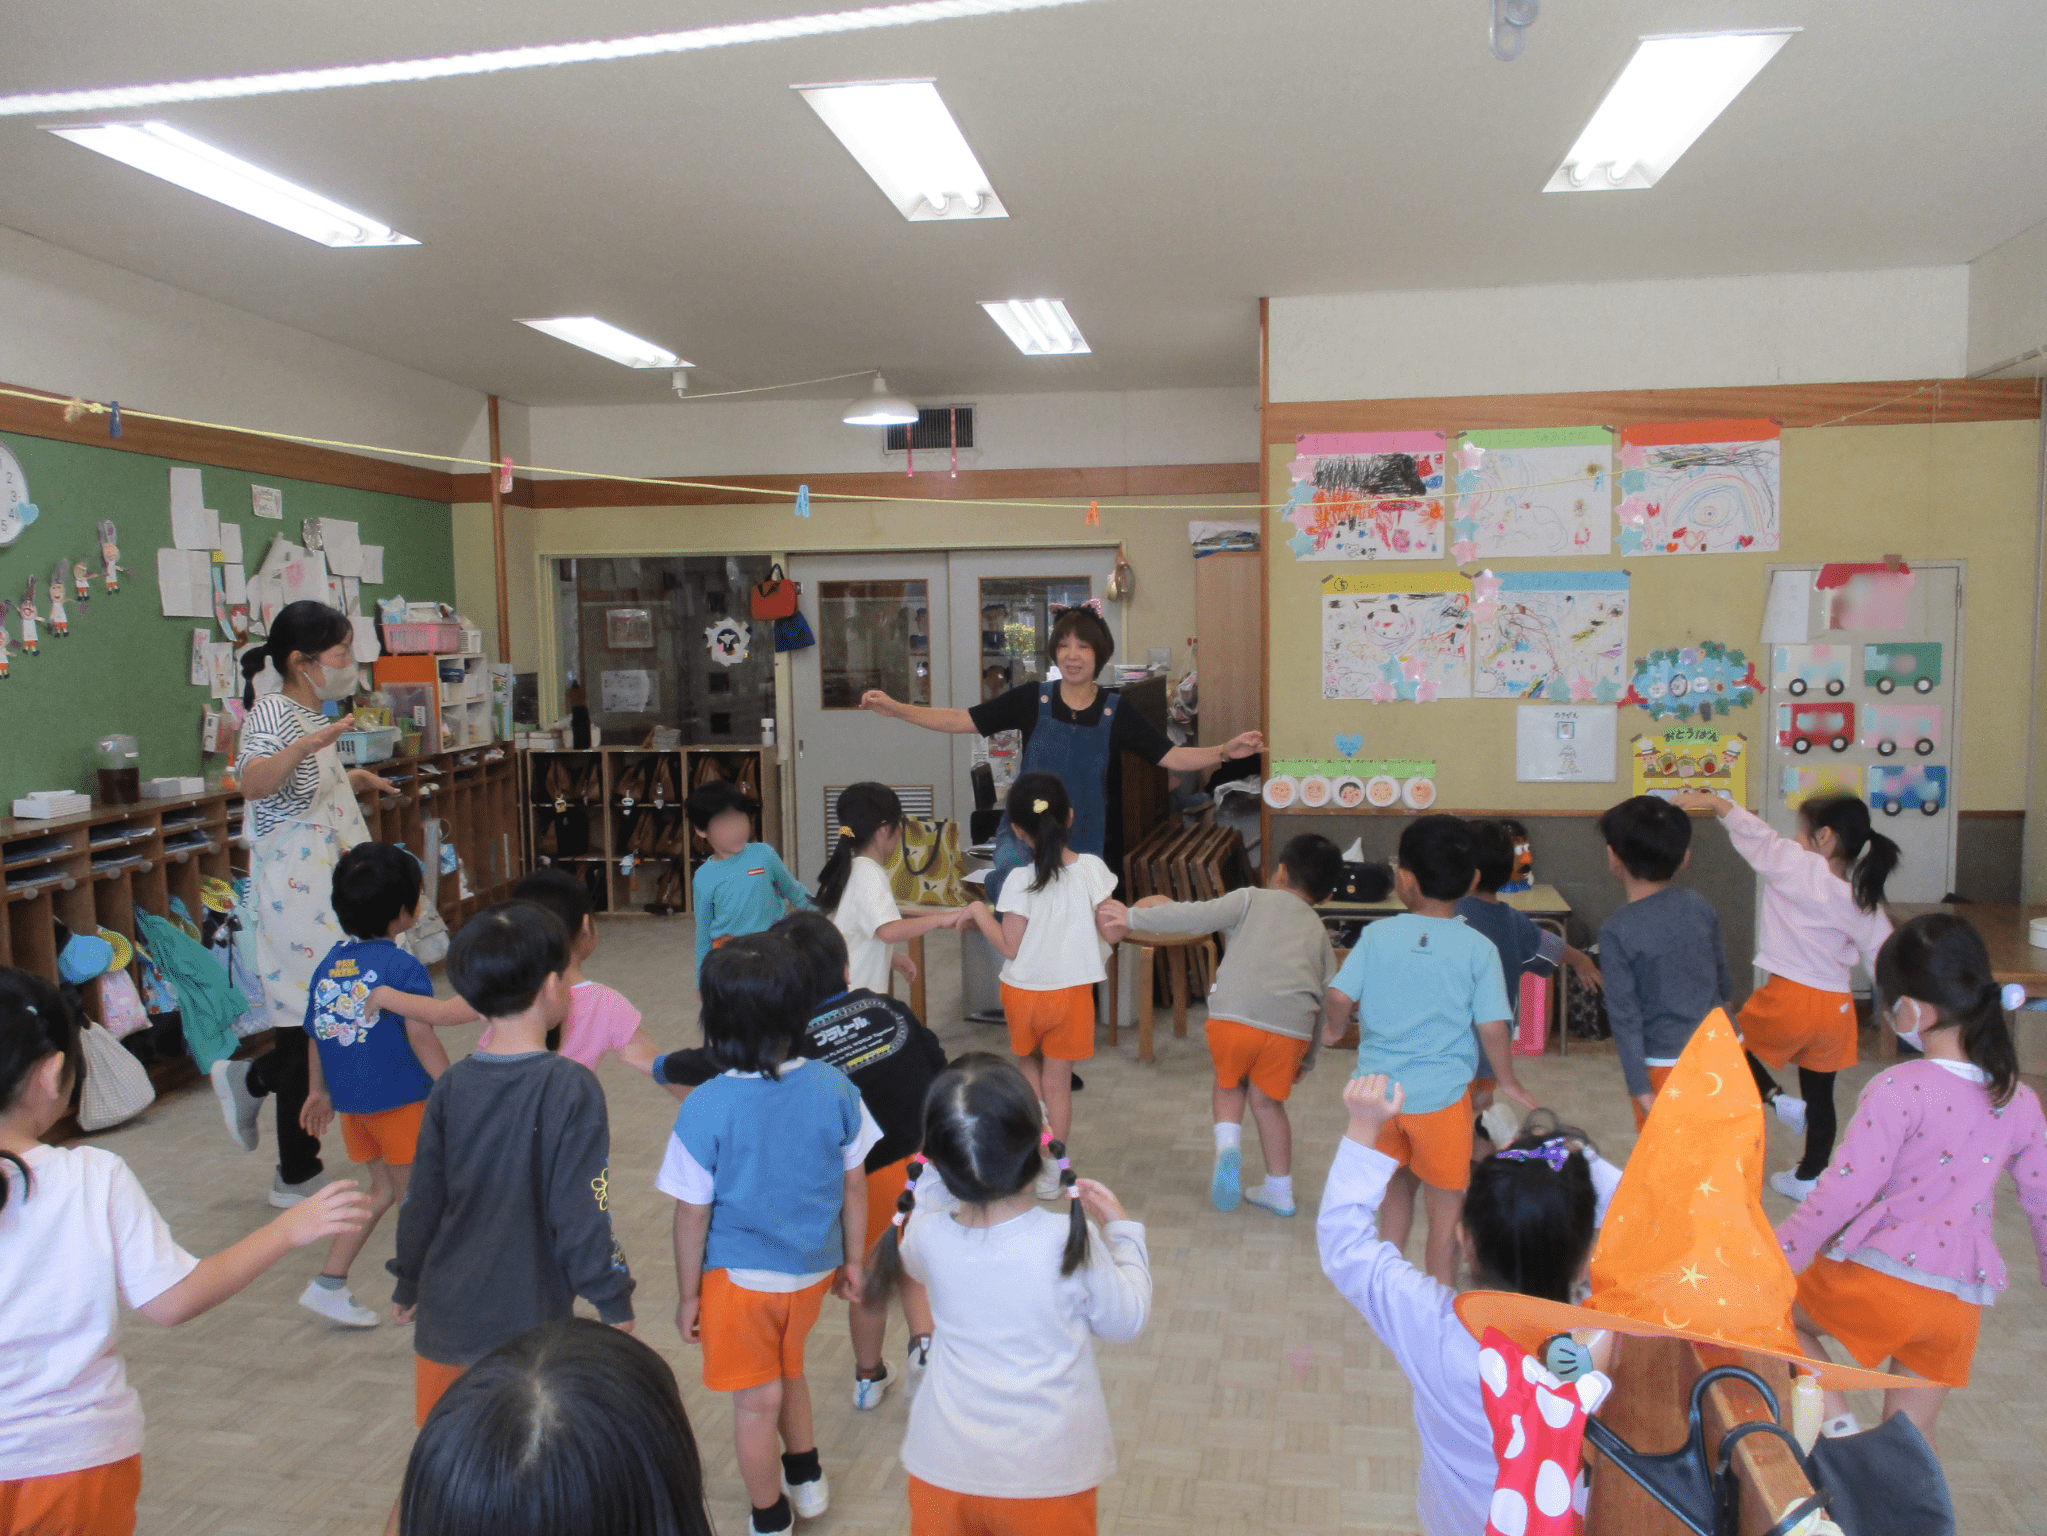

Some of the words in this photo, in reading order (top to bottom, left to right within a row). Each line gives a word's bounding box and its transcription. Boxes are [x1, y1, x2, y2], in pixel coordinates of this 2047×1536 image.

[1664, 727, 1718, 742] おとうばん
[813, 1016, 868, 1046] プラレール
